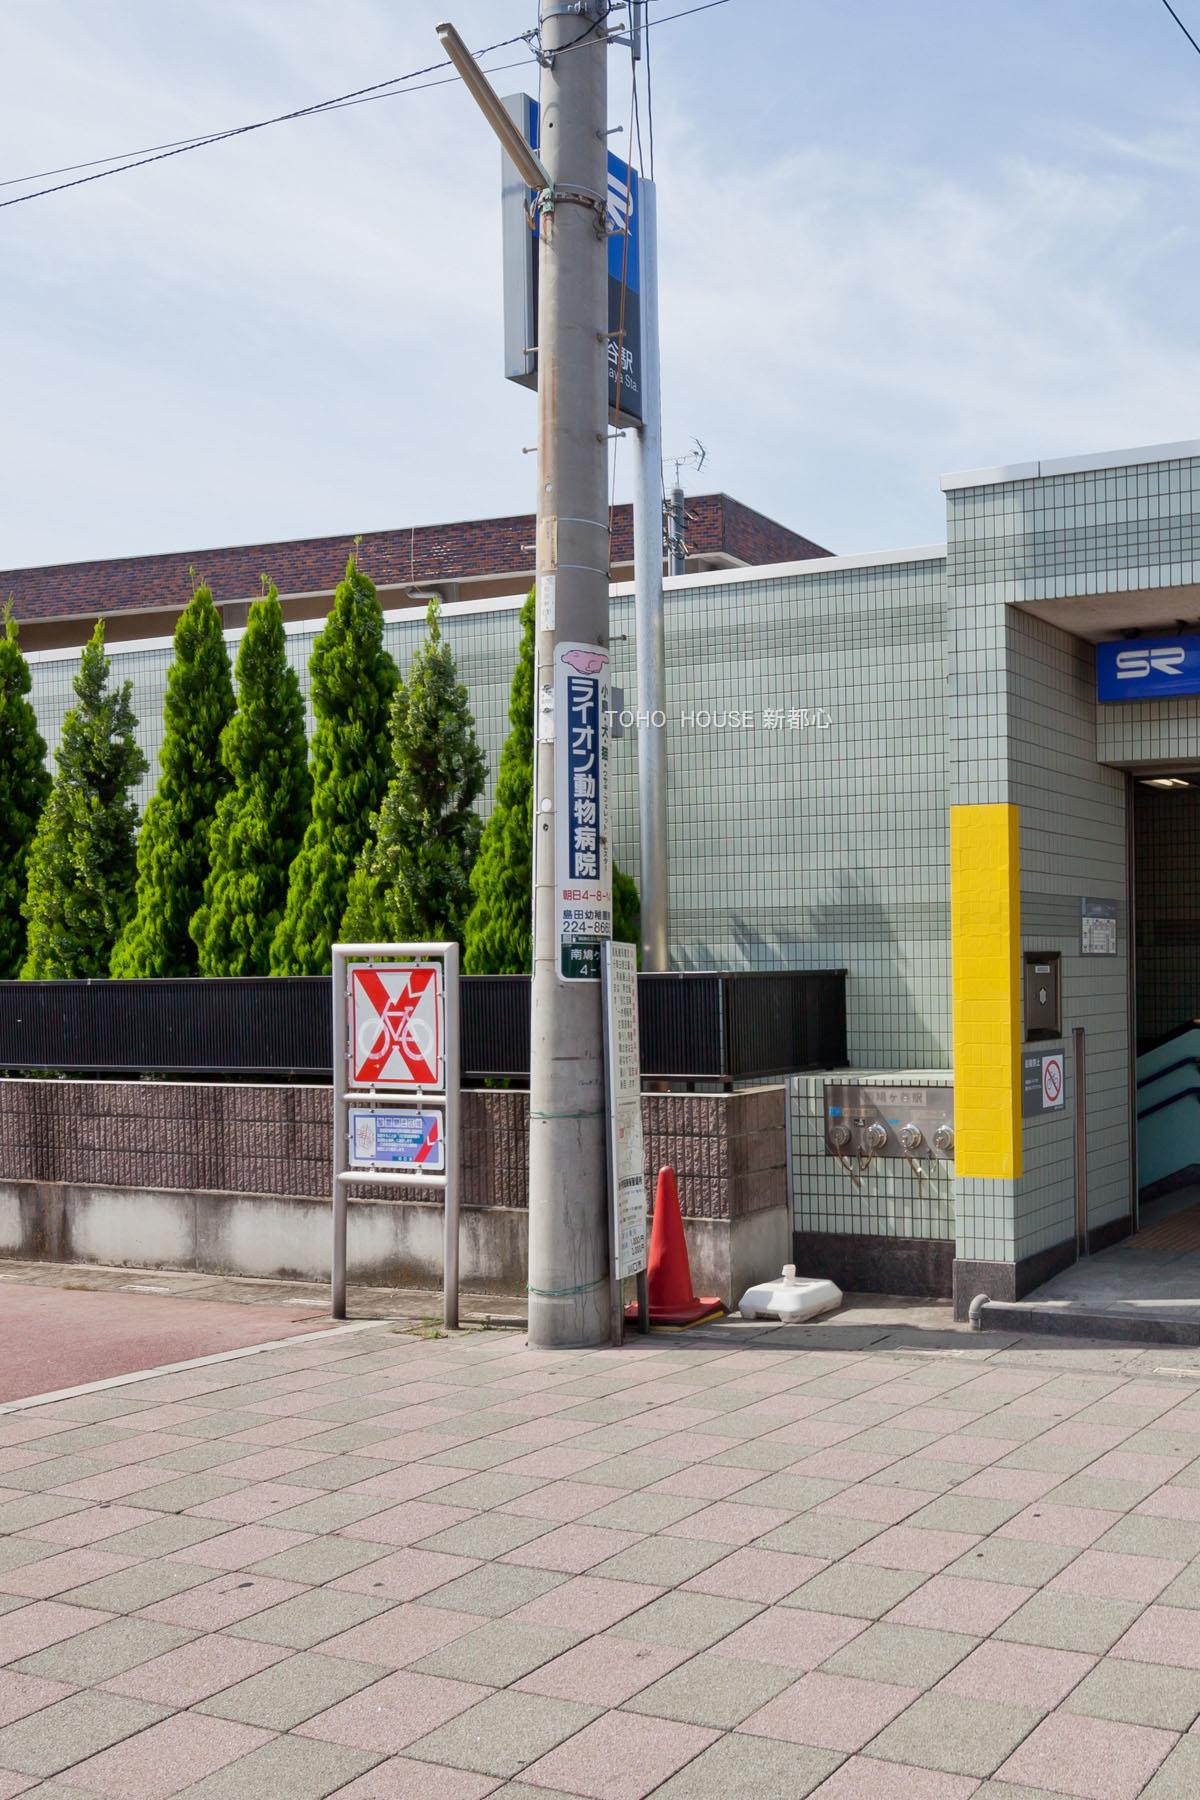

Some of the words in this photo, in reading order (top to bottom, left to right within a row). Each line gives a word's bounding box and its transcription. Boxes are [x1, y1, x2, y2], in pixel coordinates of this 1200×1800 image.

[1116, 647, 1185, 680] SR
[571, 678, 598, 877] ライオン動物病院
